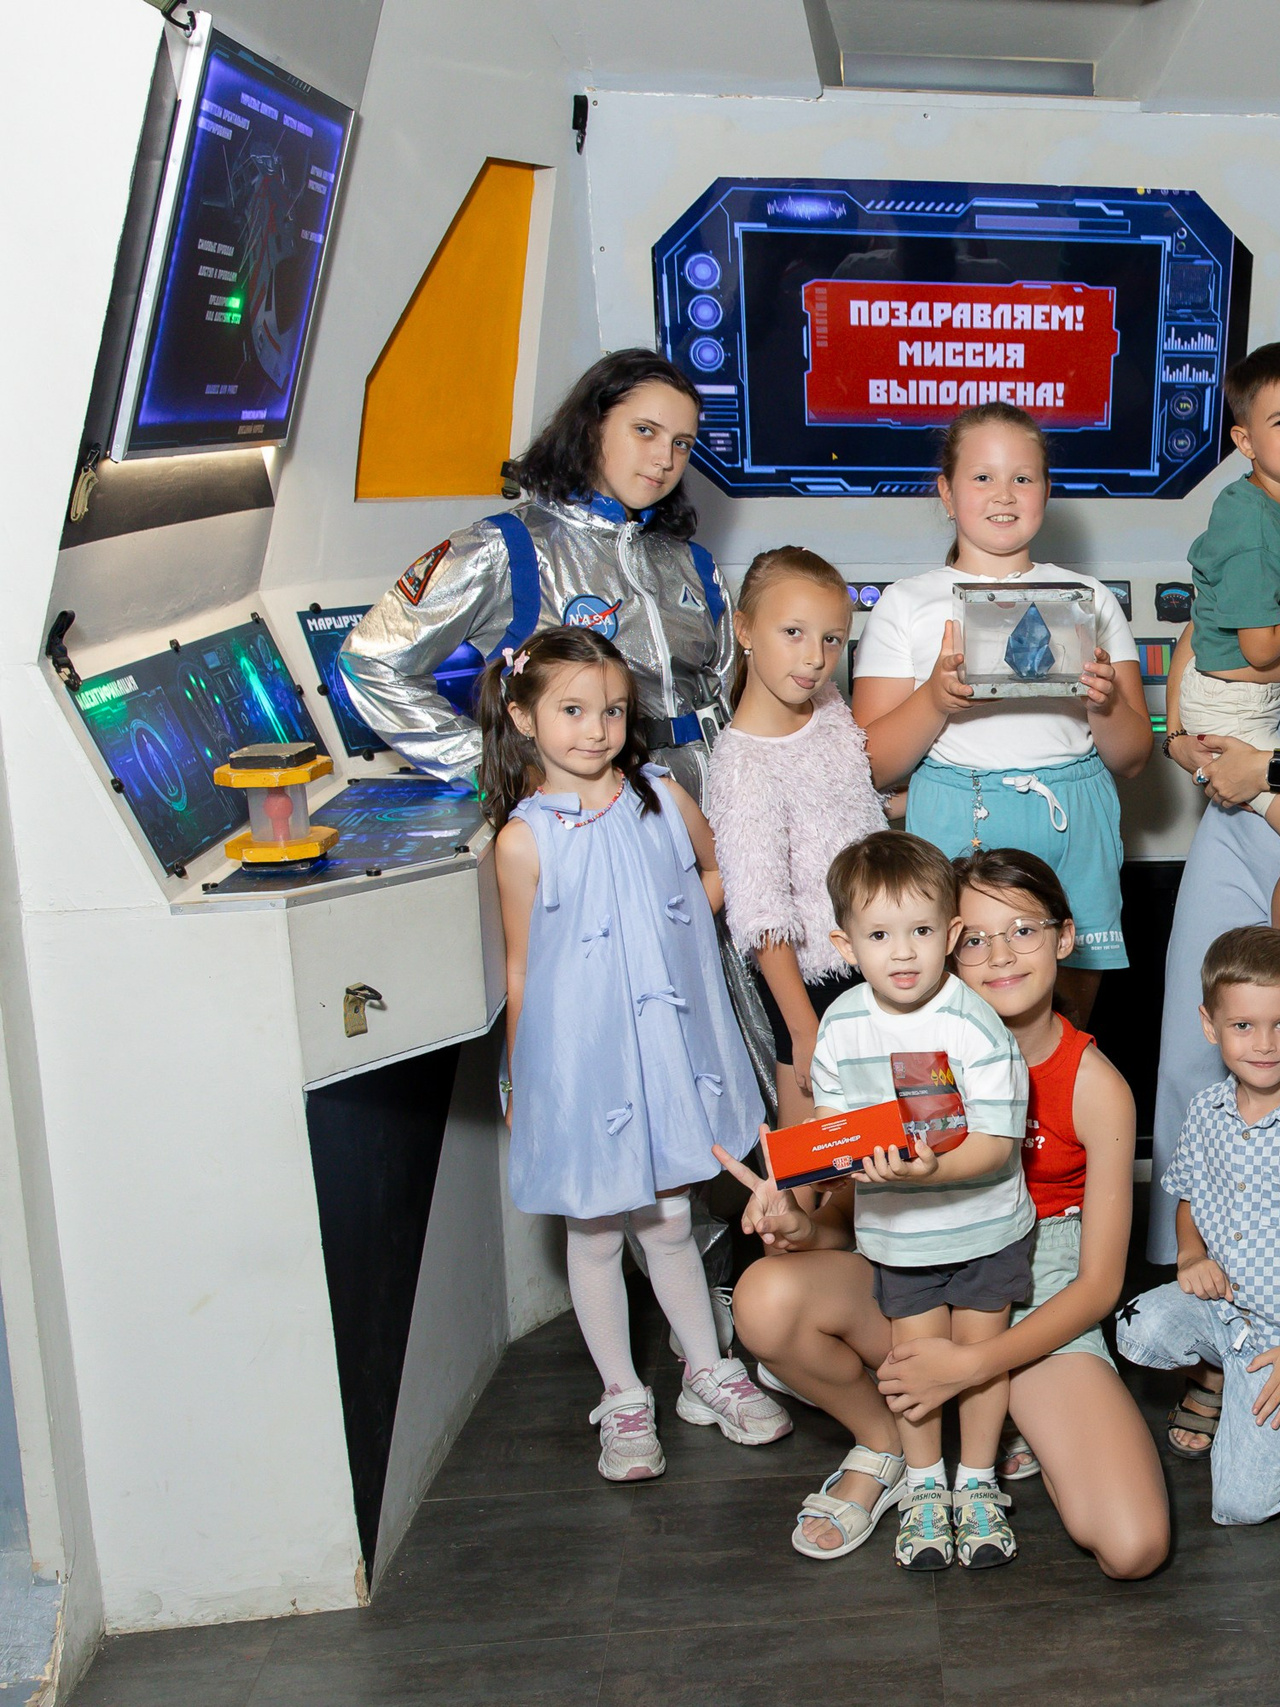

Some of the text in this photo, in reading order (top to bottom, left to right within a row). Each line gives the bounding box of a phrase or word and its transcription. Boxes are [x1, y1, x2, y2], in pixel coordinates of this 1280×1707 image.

[849, 299, 1085, 332] ПОЗДРАВЛЯЕМ!
[898, 340, 1025, 369] МИССИЯ
[868, 379, 1065, 407] ВЫПОЛНЕНА!
[306, 613, 363, 631] МАРШРУТ
[569, 613, 614, 626] NASA
[75, 674, 139, 711] ИДЕНТИФИКАЦИЯ
[811, 1134, 862, 1153] АВИАЛАЙНЕР
[911, 1492, 942, 1502] FASHION
[969, 1492, 999, 1500] FASHION
